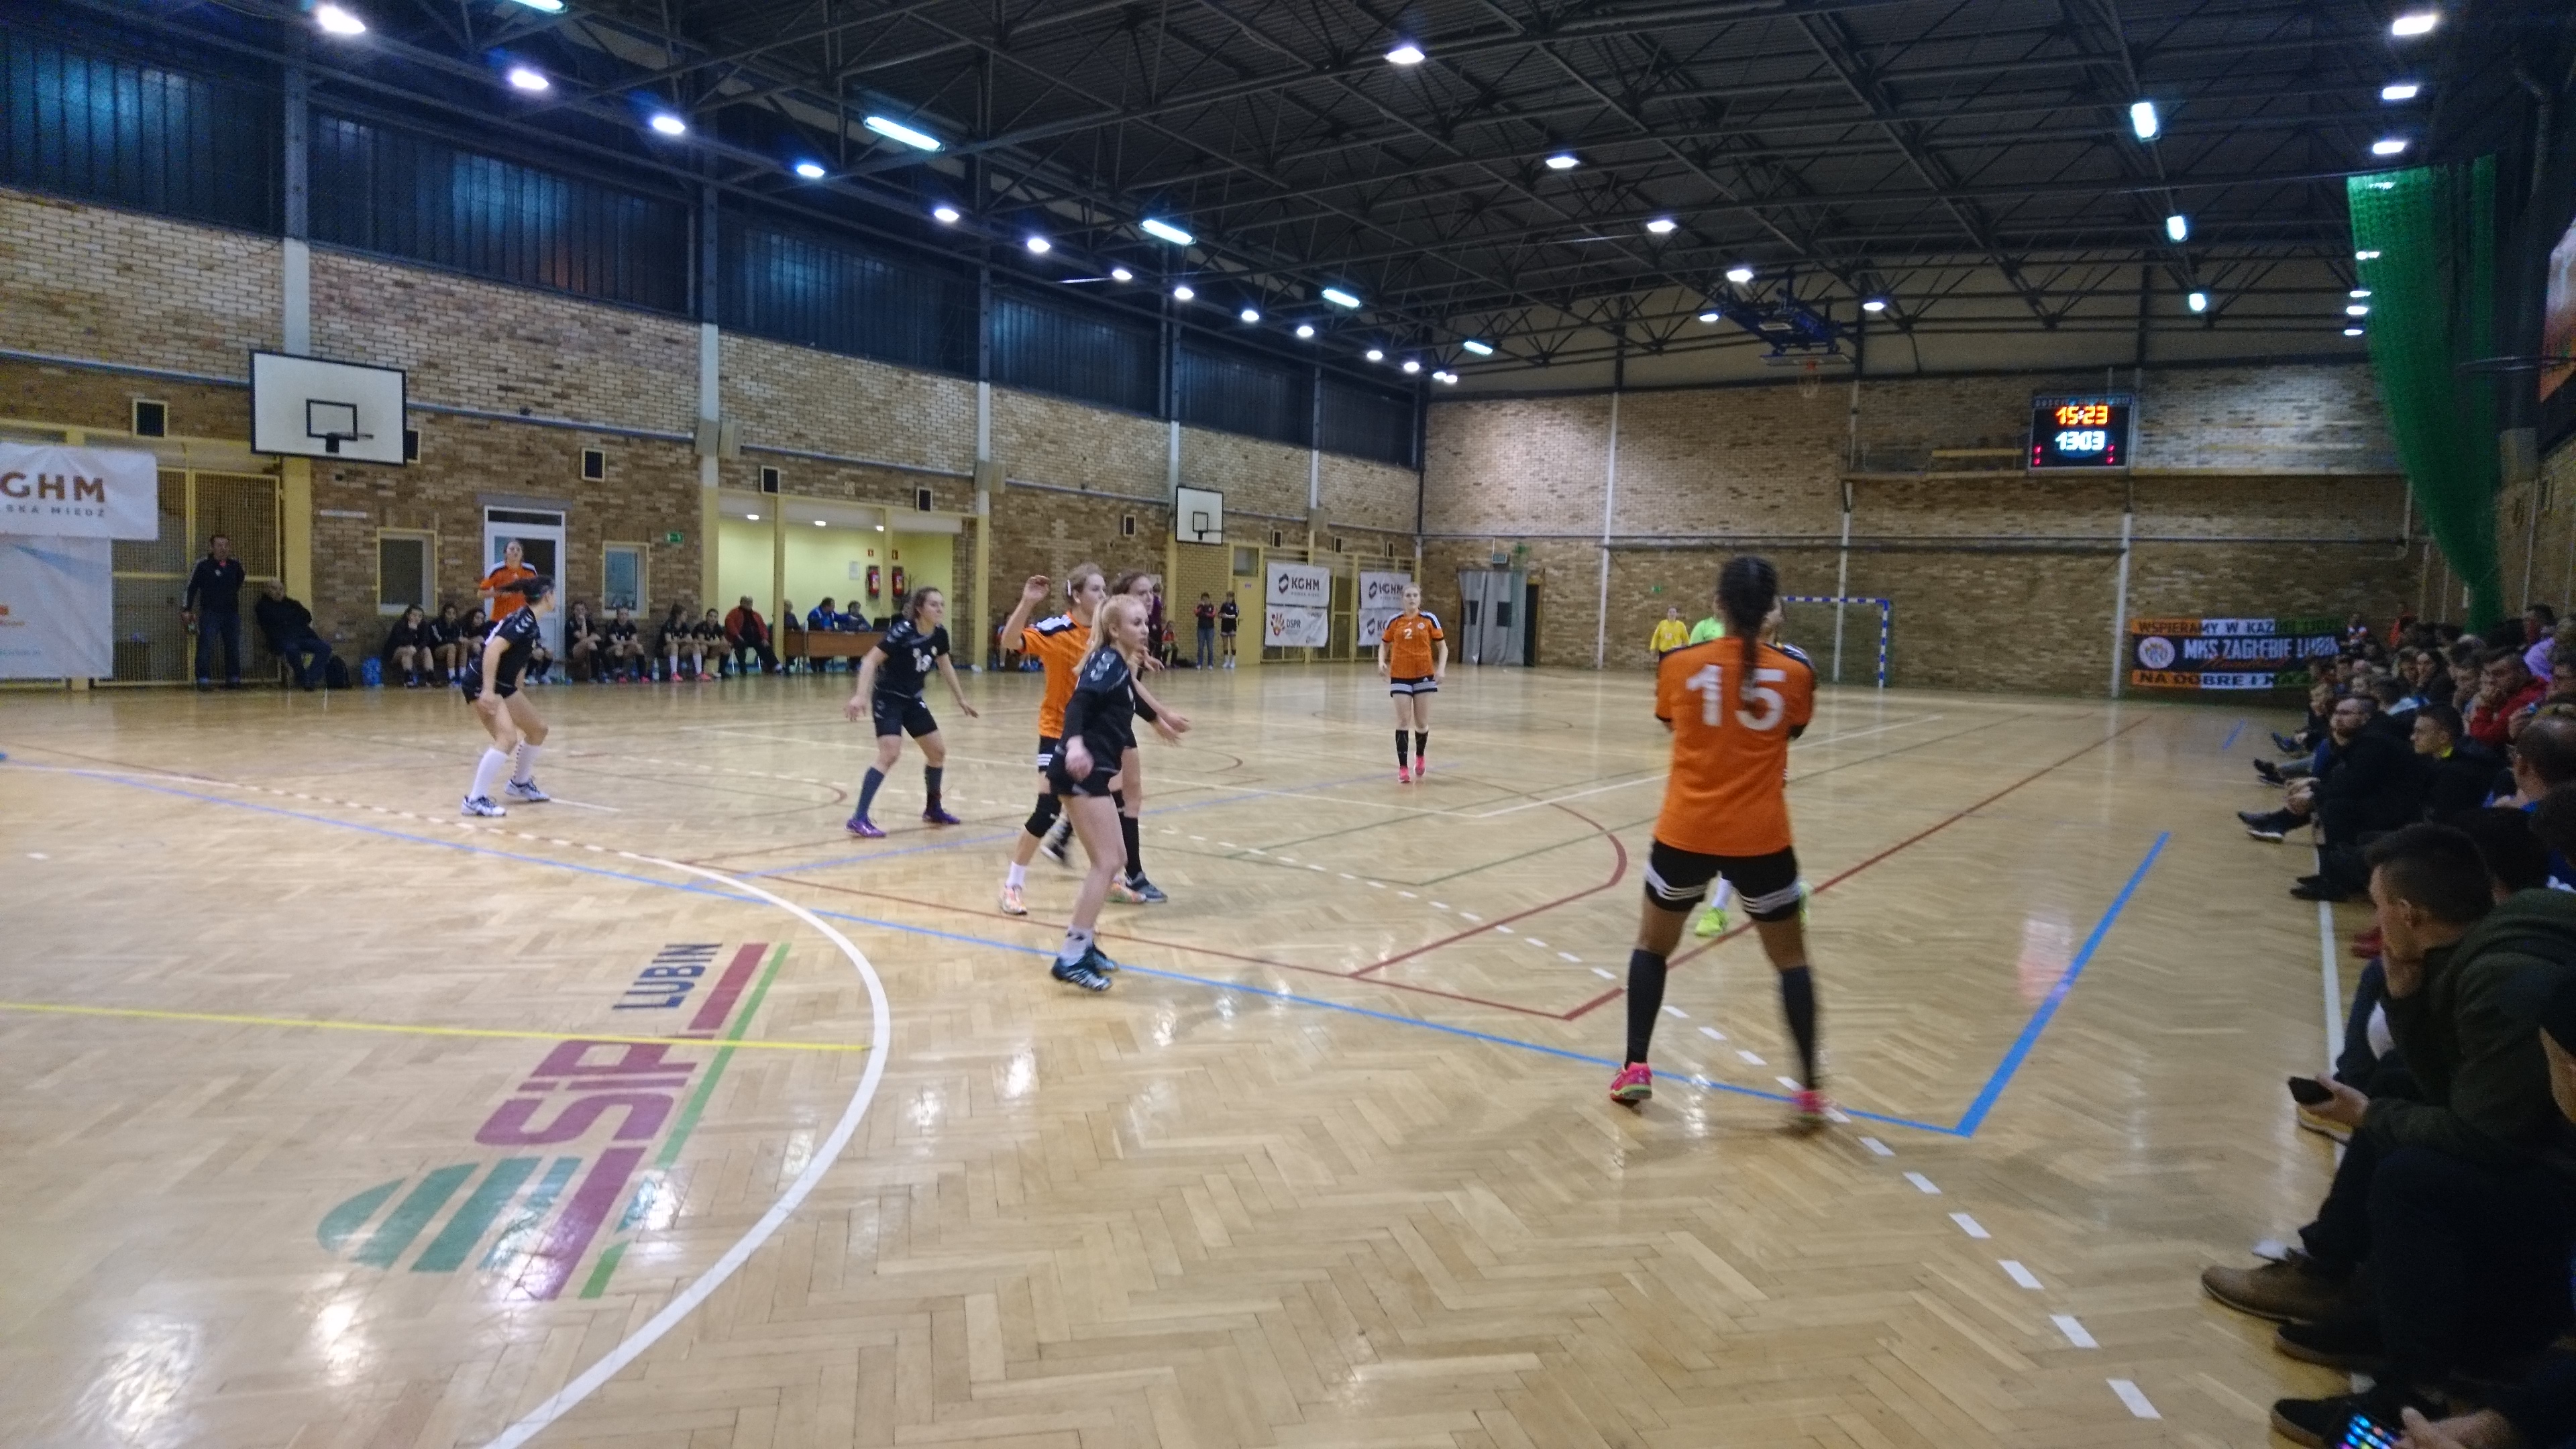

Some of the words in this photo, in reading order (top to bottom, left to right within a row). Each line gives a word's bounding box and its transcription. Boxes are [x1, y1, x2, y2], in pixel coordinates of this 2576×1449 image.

[2056, 406, 2108, 425] 15:23
[1291, 577, 1320, 591] KGHM
[1404, 628, 1413, 639] 2
[2226, 623, 2239, 633] W
[2184, 639, 2218, 659] MKS
[1685, 663, 1786, 731] 15
[611, 943, 722, 1011] LUBIN
